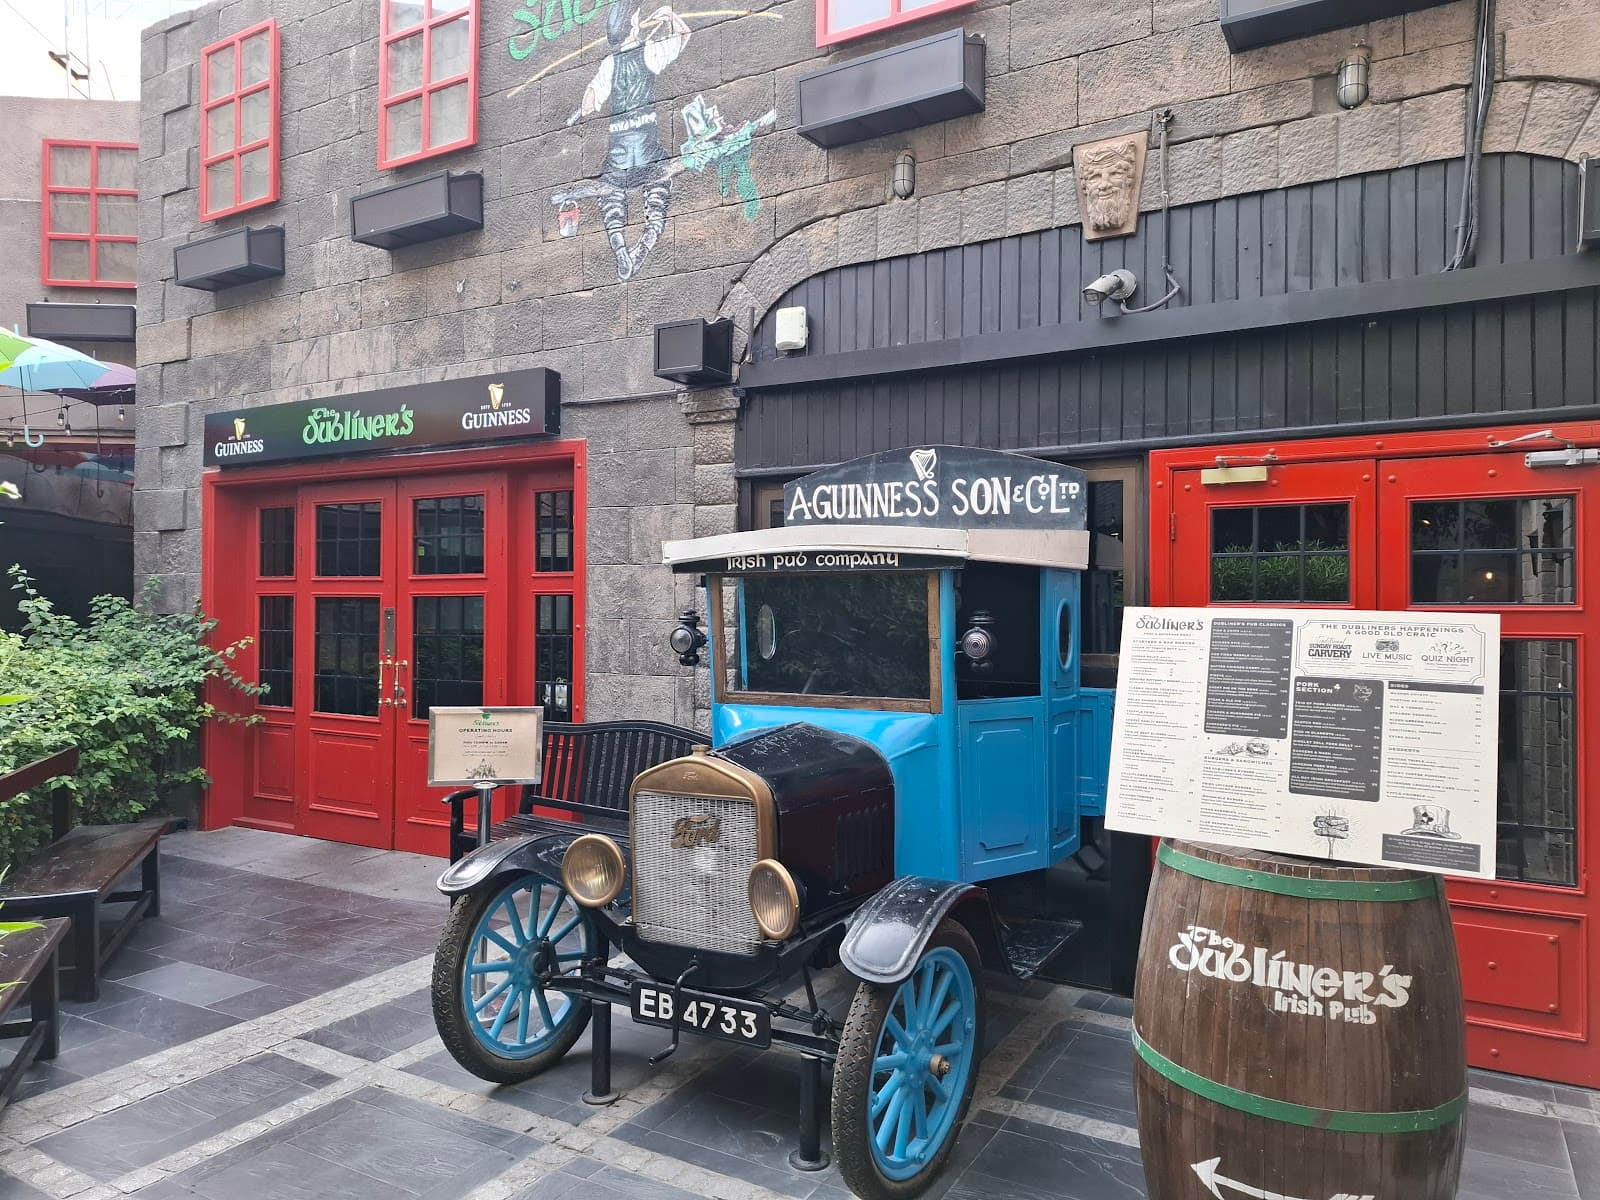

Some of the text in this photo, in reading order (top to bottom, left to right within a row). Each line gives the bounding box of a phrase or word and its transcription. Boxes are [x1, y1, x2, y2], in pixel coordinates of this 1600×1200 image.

[311, 407, 337, 420] The
[461, 408, 531, 430] GUINNESS
[214, 439, 264, 457] GUINNESS
[951, 477, 1012, 516] SON
[1308, 648, 1353, 659] CARVERY
[1362, 652, 1413, 661] LIVE MUSIC
[1420, 654, 1475, 664] QUIZ NIGHT
[1295, 686, 1333, 694] SECTION
[670, 815, 721, 849] Ford
[1186, 925, 1236, 949] The
[638, 987, 758, 1040] EB 4733
[1274, 990, 1378, 1026] Irish Pub
